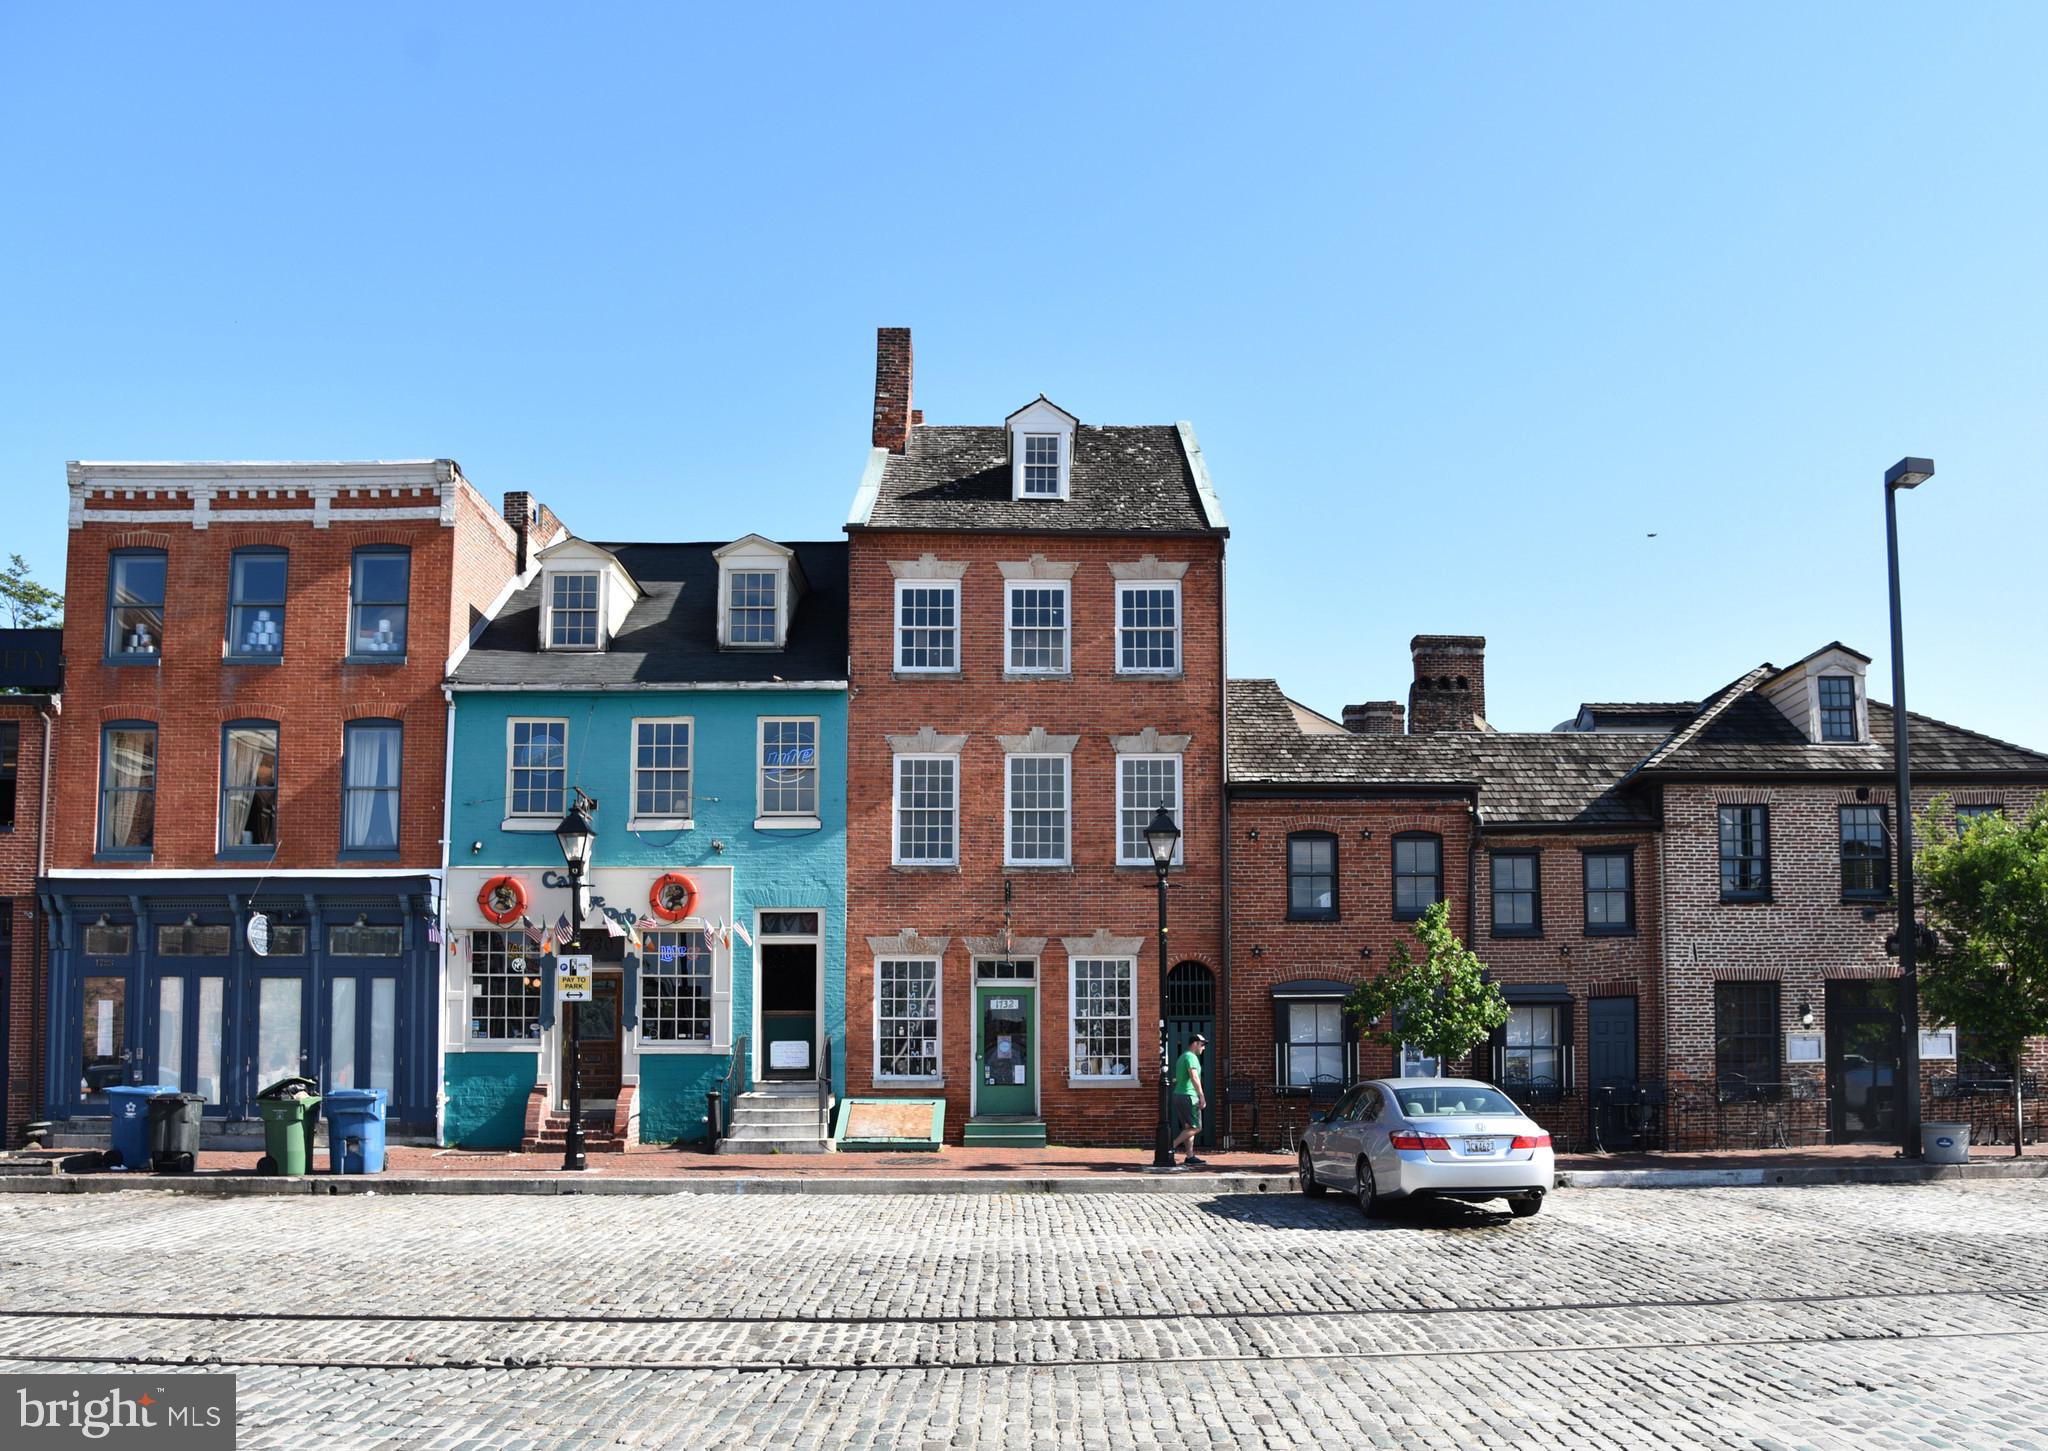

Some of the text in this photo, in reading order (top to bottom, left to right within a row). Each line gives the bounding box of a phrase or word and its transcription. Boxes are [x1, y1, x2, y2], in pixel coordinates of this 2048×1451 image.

[541, 870, 572, 889] Ca
[602, 907, 637, 925] Pub
[995, 1000, 1015, 1009] 1732
